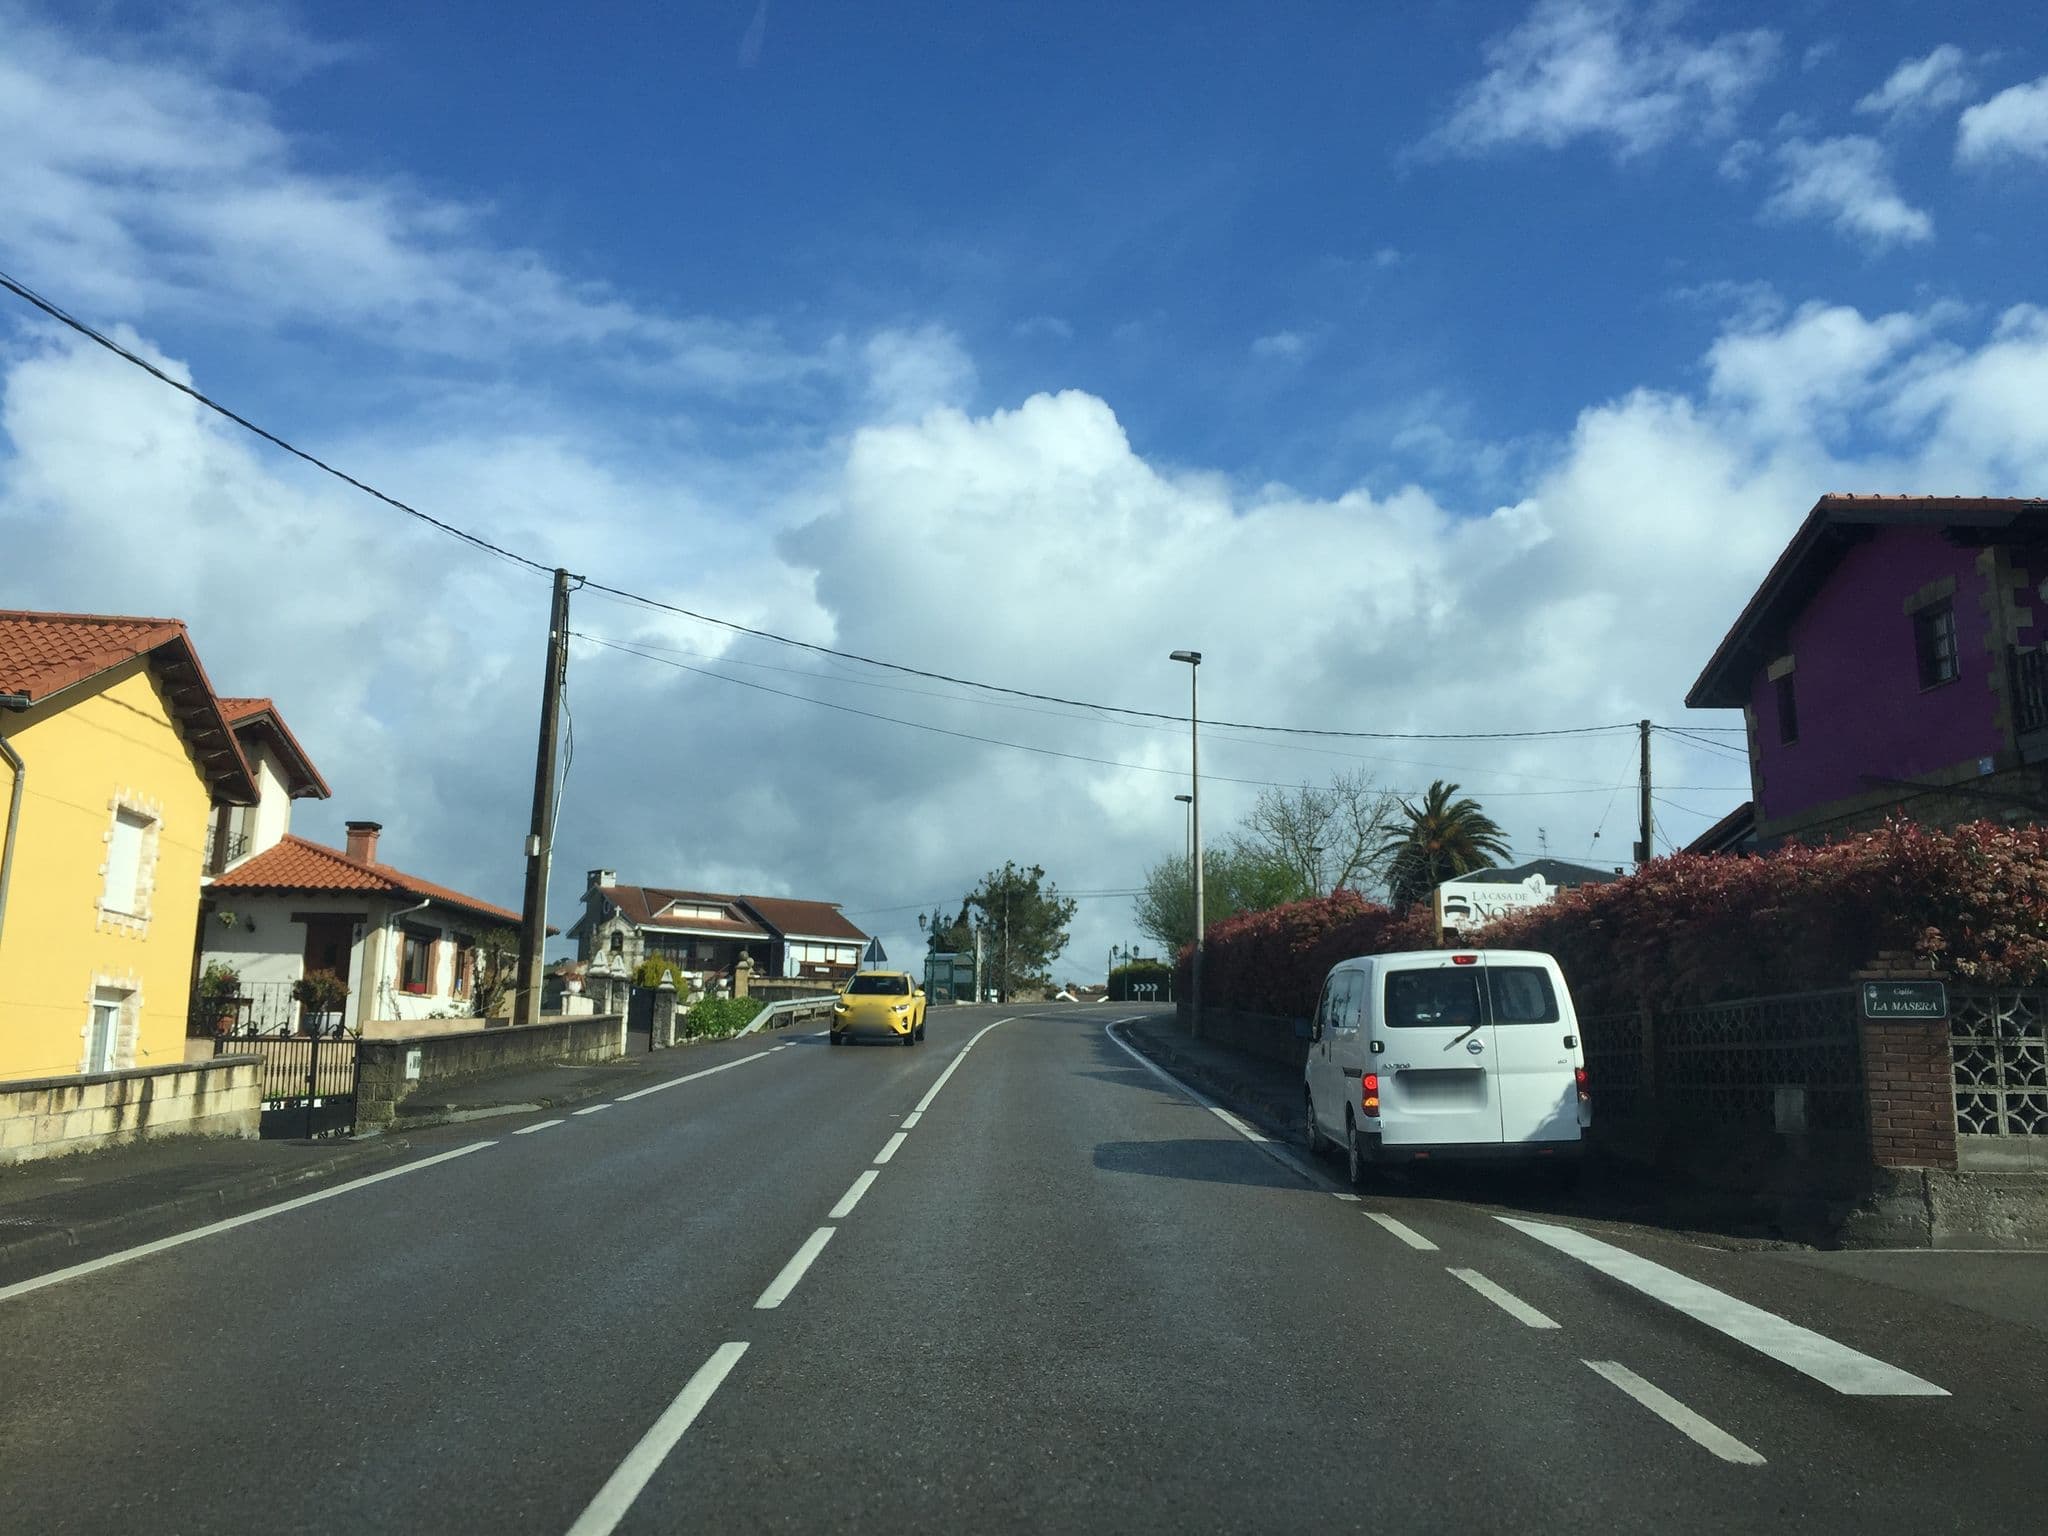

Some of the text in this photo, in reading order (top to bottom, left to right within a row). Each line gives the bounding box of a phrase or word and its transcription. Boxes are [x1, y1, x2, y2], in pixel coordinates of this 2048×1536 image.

[1472, 891, 1527, 901] LA CASA DE
[1873, 1001, 1938, 1011] LA MASERA
